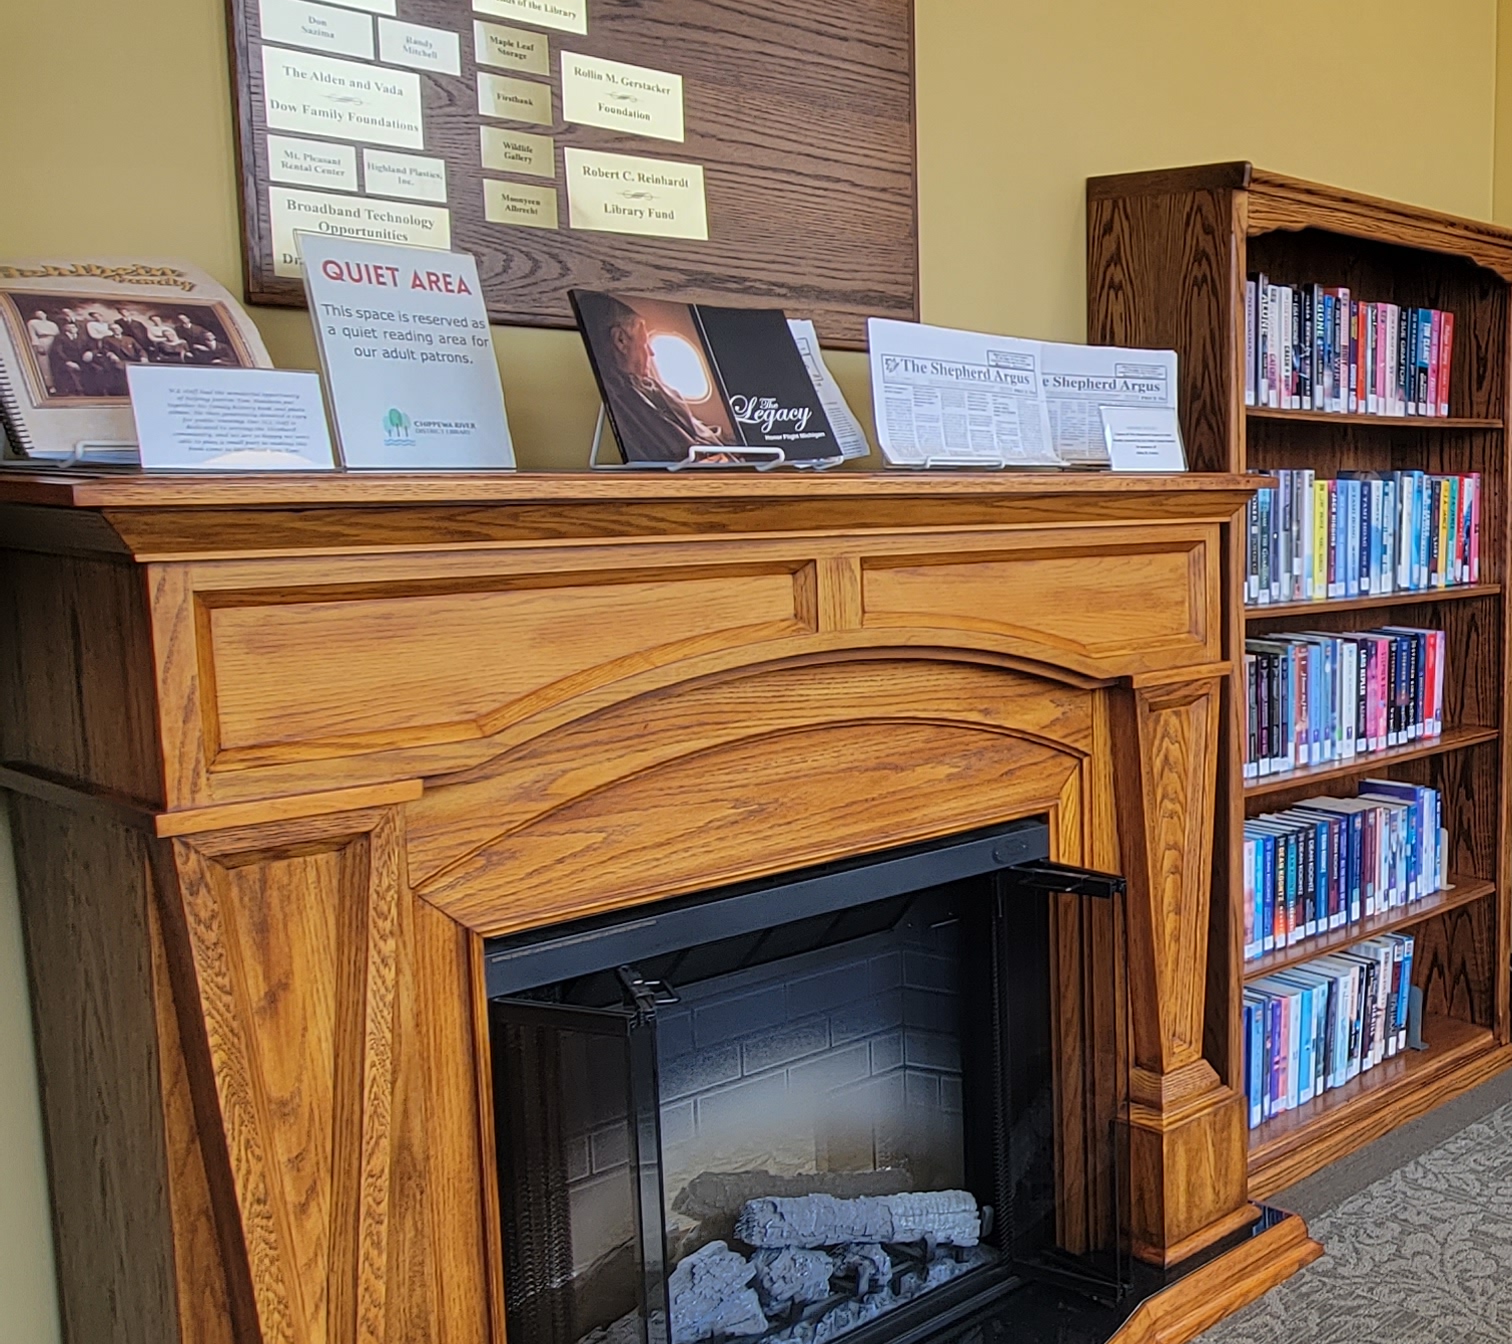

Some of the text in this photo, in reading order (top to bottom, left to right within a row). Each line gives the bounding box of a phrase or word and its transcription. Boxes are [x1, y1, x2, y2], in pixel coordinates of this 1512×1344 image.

[528, 0, 542, 11] the
[544, 4, 577, 20] Library
[308, 16, 327, 27] Don
[490, 35, 534, 52] Maple Leaf
[497, 48, 527, 61] Storage
[282, 65, 404, 97] The Alden and Vada
[574, 66, 671, 95] Rollin M. Gerstacker
[270, 99, 419, 132] Dow Family Foundations
[598, 102, 651, 121] Foundation
[502, 141, 533, 154] Wildlife
[303, 153, 341, 166] Pleasant
[504, 151, 533, 164] Gallery
[281, 160, 345, 177] Rental Center
[366, 162, 407, 176] Highland
[582, 165, 689, 188] Robert C. Reinhardt
[286, 198, 435, 230] Broadband Technology
[604, 203, 675, 220] Library Fund
[318, 222, 408, 242] Opportunities
[321, 259, 473, 296] QUIET AREA
[320, 304, 486, 330] This space is reserved as
[327, 326, 490, 348] a quiet reading area for
[353, 347, 474, 365] our adult patrons.
[1399, 340, 1407, 386] GRAFTON
[900, 357, 928, 374] The
[931, 362, 991, 385] Shepherd
[993, 369, 1030, 386] Argus
[1052, 376, 1117, 392] Shepherd
[1119, 379, 1161, 395] Argus
[759, 397, 779, 409] The
[730, 394, 813, 434] Legacy
